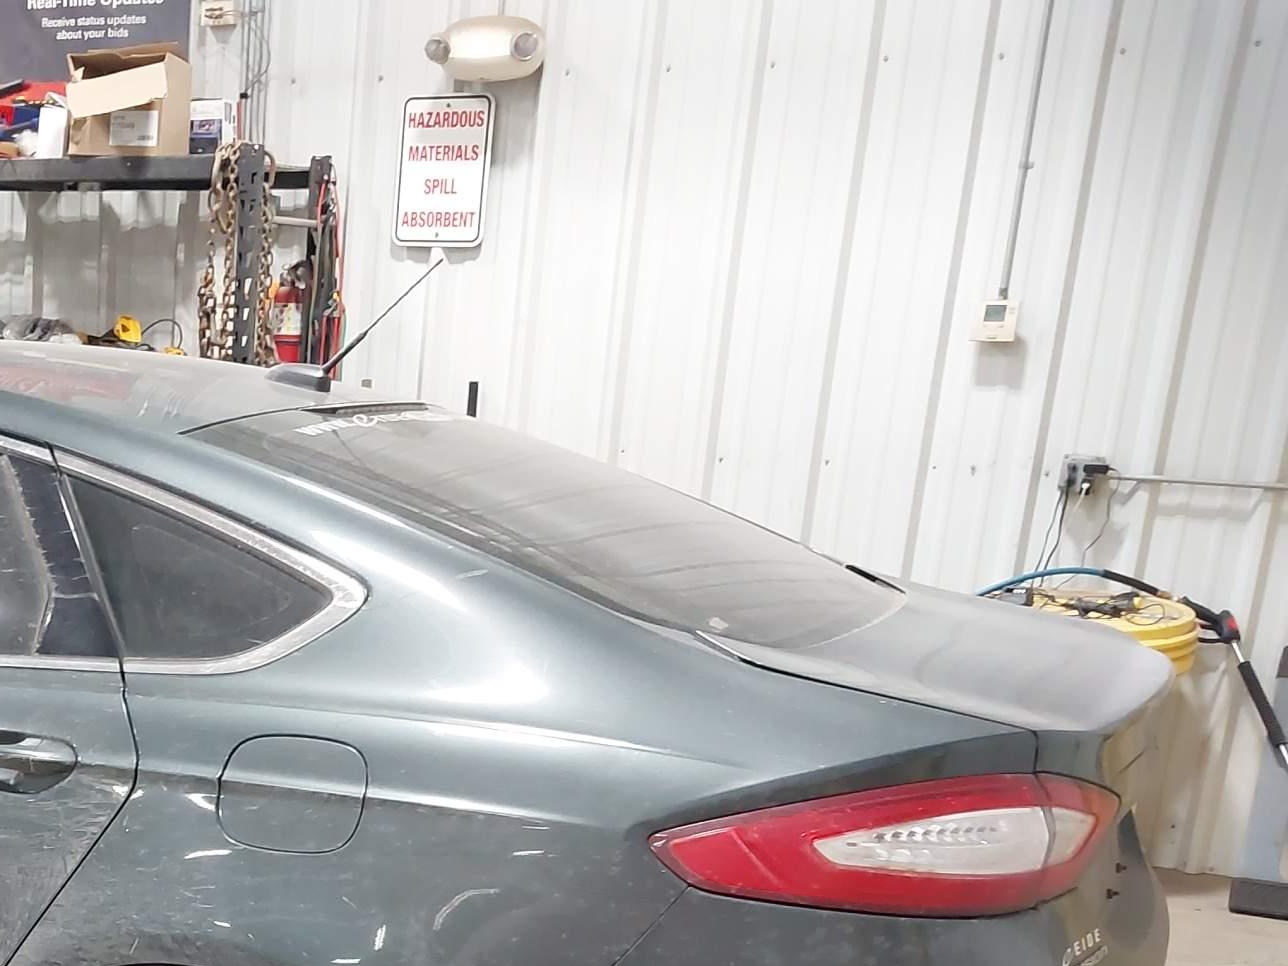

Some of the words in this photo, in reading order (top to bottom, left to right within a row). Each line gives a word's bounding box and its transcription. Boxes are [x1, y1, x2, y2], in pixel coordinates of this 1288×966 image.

[41, 17, 75, 28] Receive
[77, 16, 105, 26] status
[107, 15, 146, 26] updates
[56, 29, 82, 40] about
[83, 28, 105, 41] your
[107, 27, 129, 38] bids
[408, 110, 485, 128] HAZARDOUS
[408, 144, 480, 162] MATERIALS
[423, 178, 457, 195] SPILL
[402, 211, 476, 228] ABSORBENT
[1074, 927, 1102, 956] EIDE
